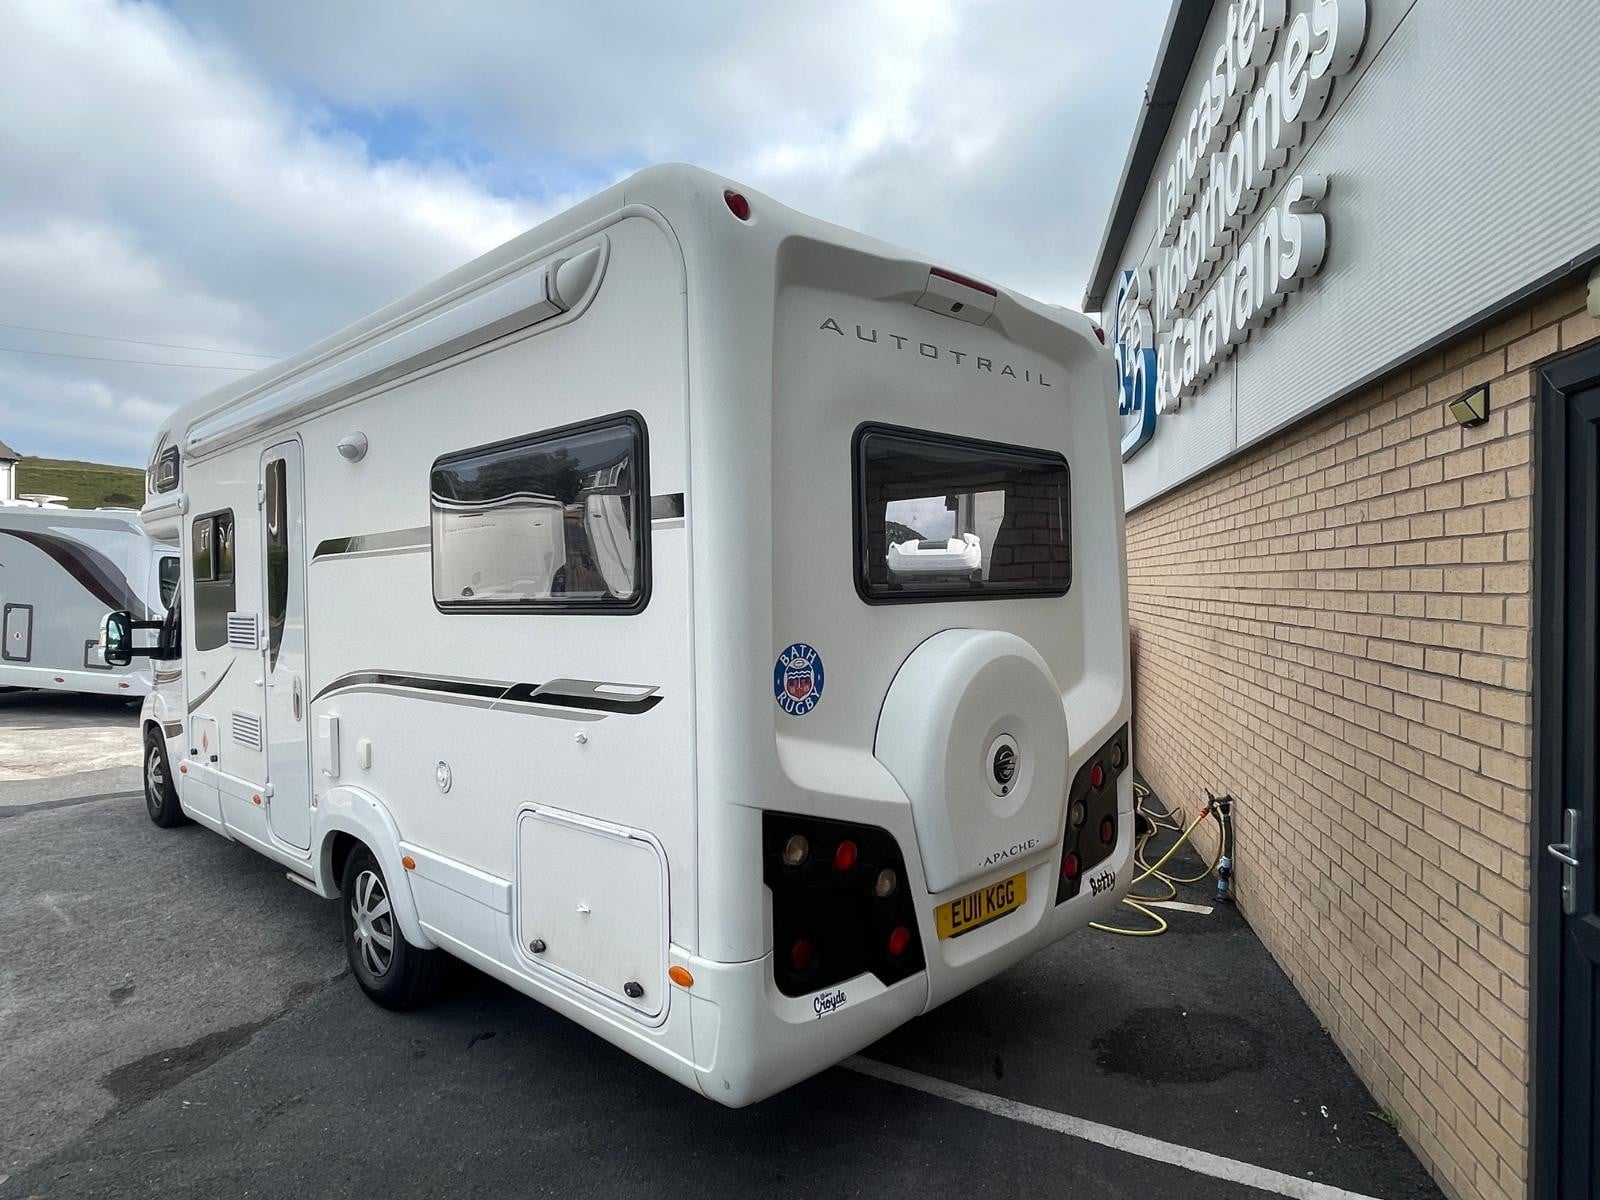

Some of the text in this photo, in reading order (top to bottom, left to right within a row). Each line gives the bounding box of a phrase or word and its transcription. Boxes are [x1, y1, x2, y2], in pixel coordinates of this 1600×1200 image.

[1156, 0, 1338, 333] Motorhomes
[820, 318, 1051, 387] AUTOTRAIL
[780, 645, 816, 667] BATH
[777, 686, 820, 715] RUGBY
[983, 839, 1036, 867] APACHE
[1089, 870, 1116, 897] Betty
[951, 880, 1015, 929] EU11 KGG
[814, 990, 847, 1013] Croyde
